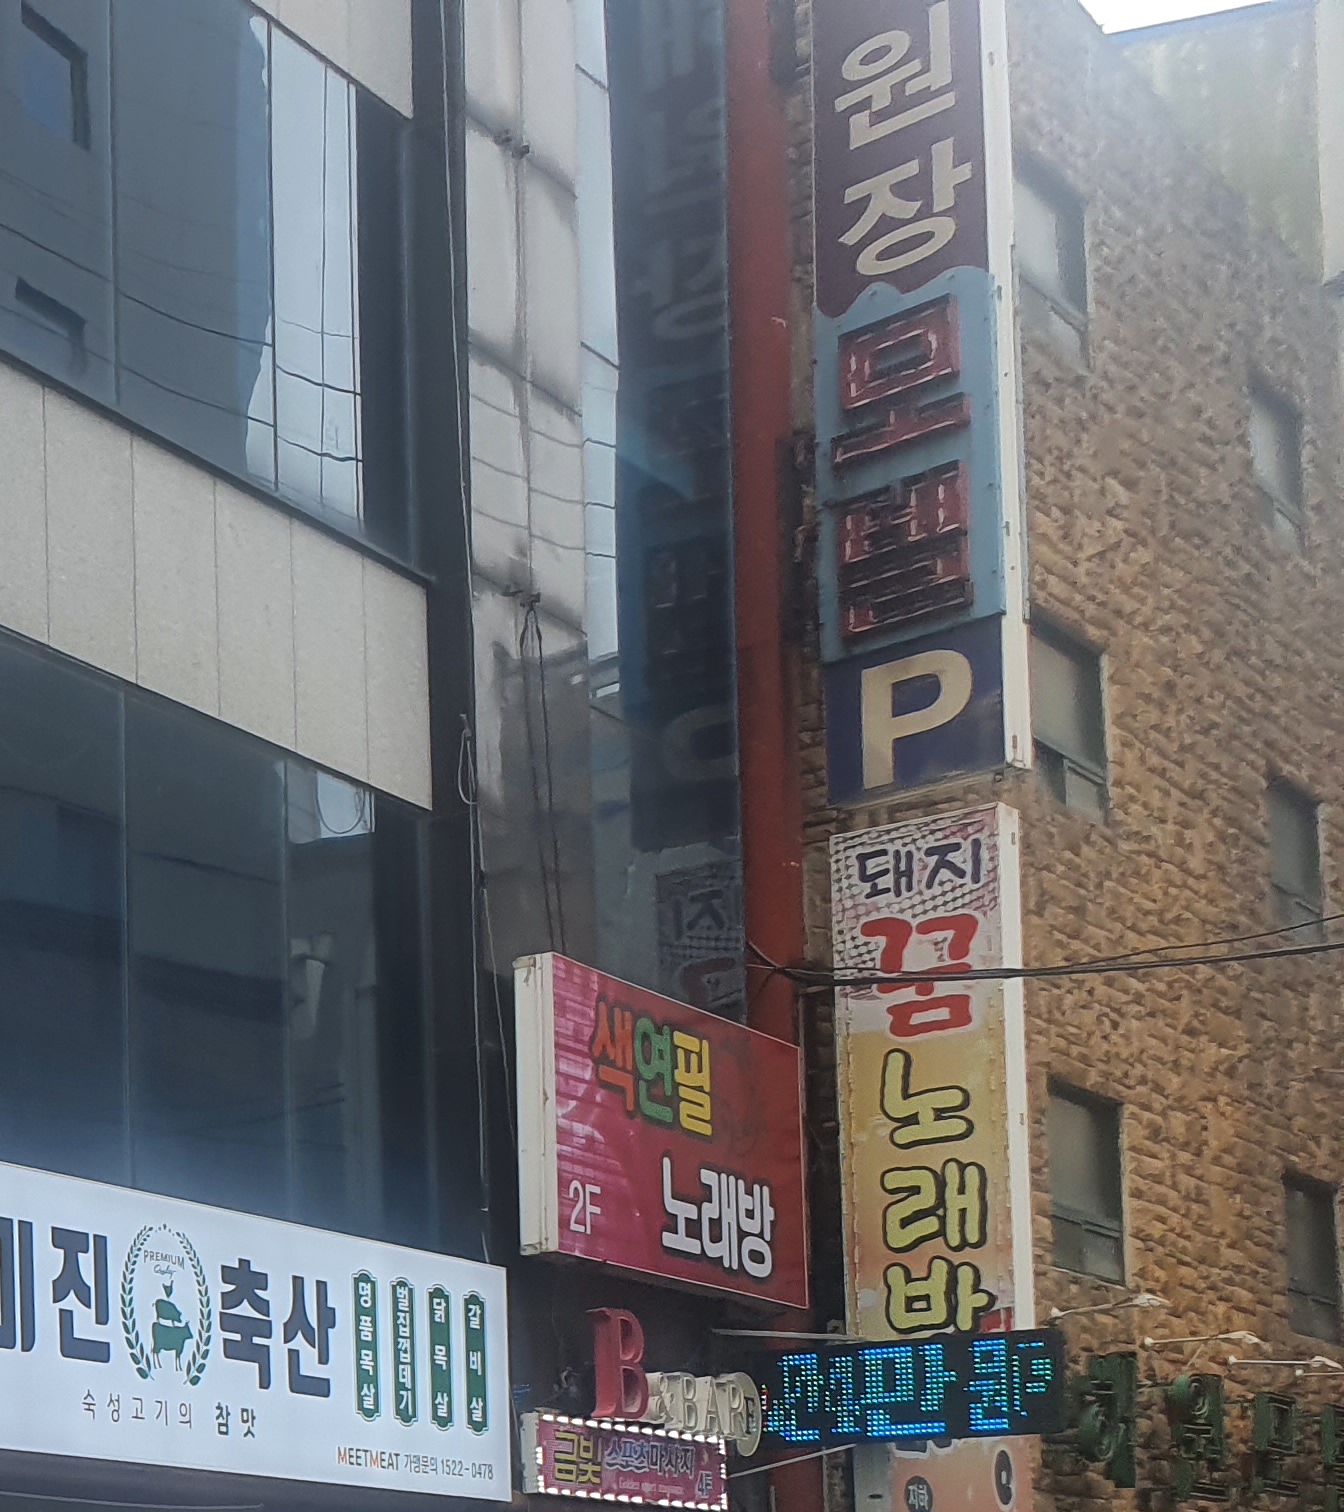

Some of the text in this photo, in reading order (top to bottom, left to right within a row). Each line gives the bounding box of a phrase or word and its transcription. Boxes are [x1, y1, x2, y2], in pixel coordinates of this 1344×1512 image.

[861, 648, 973, 790] P
[856, 837, 981, 899] 돼지
[592, 1001, 712, 1136] 색연필
[142, 1249, 186, 1271] PREMIUM
[568, 1180, 601, 1235] 2F
[662, 1157, 775, 1278] 노래방
[218, 1257, 338, 1399] 축산
[357, 1282, 377, 1405] 명품목살
[396, 1281, 415, 1417] 벌집껍데기
[432, 1297, 450, 1419] 닭목살
[467, 1302, 485, 1422] 갈비살
[82, 1390, 258, 1438] 숙성고기의 참맛
[337, 1445, 494, 1480] MEETMEAT 가맹문의 1522-0478
